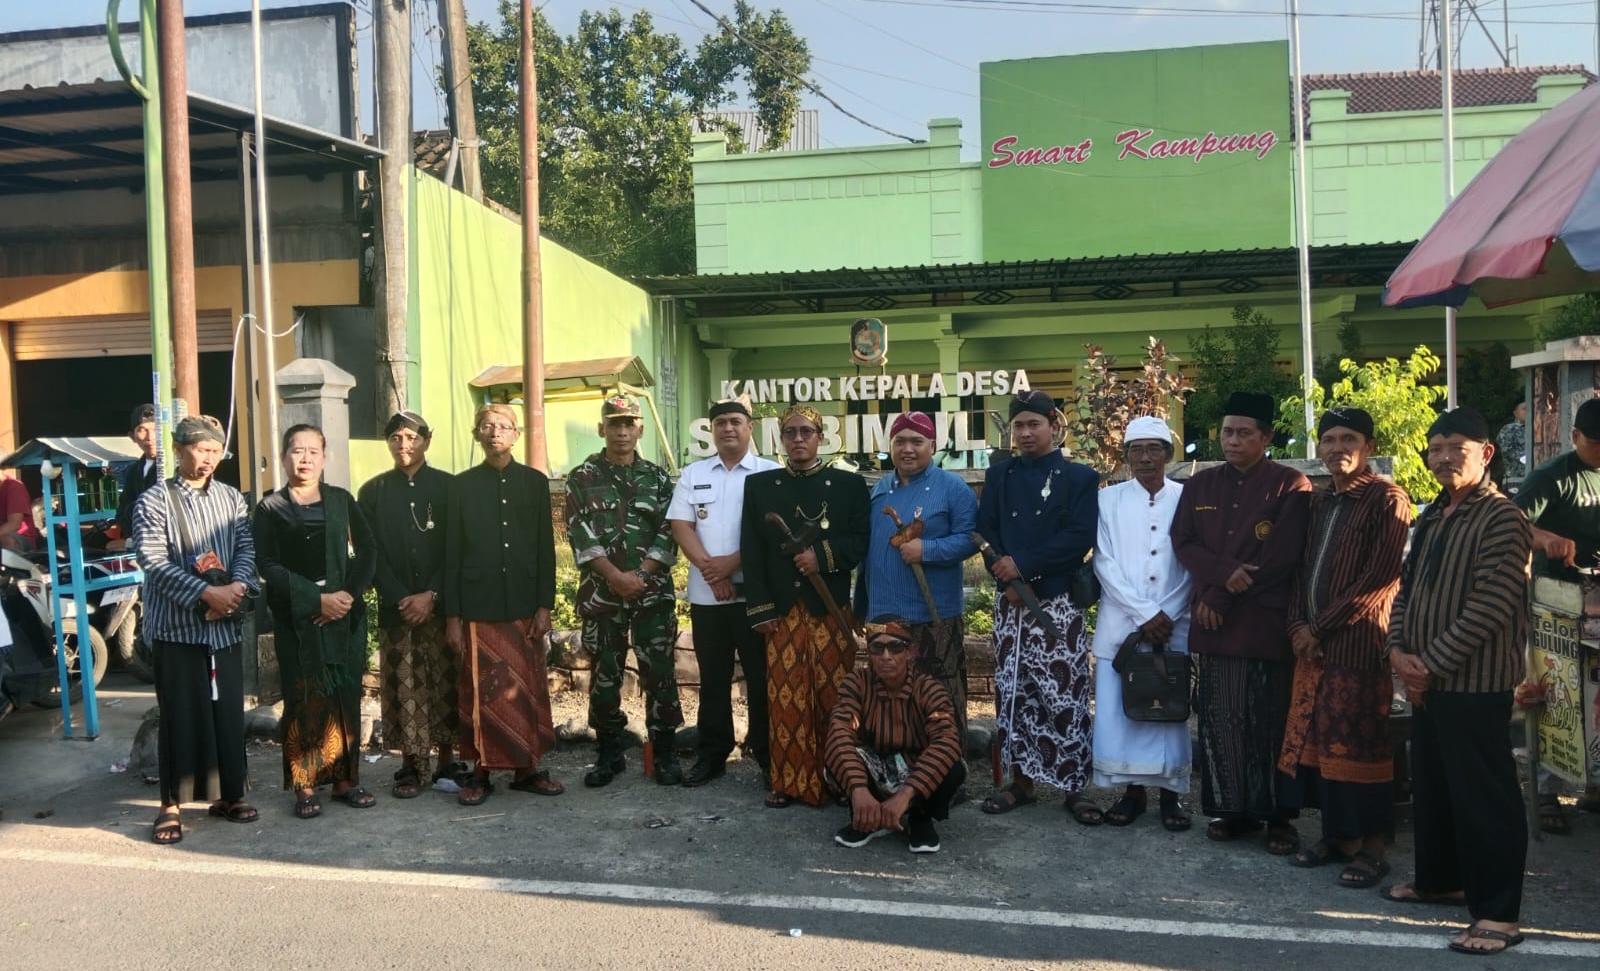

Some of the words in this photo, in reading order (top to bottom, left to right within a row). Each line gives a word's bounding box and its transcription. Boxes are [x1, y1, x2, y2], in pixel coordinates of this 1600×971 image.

[988, 135, 1092, 169] Smart
[1115, 128, 1278, 165] Kampung
[720, 376, 832, 403] KANTOR
[839, 373, 948, 401] KEPALA
[956, 369, 1031, 397] DESA
[1534, 614, 1577, 640] Telor
[1533, 630, 1578, 660] GULUNG
